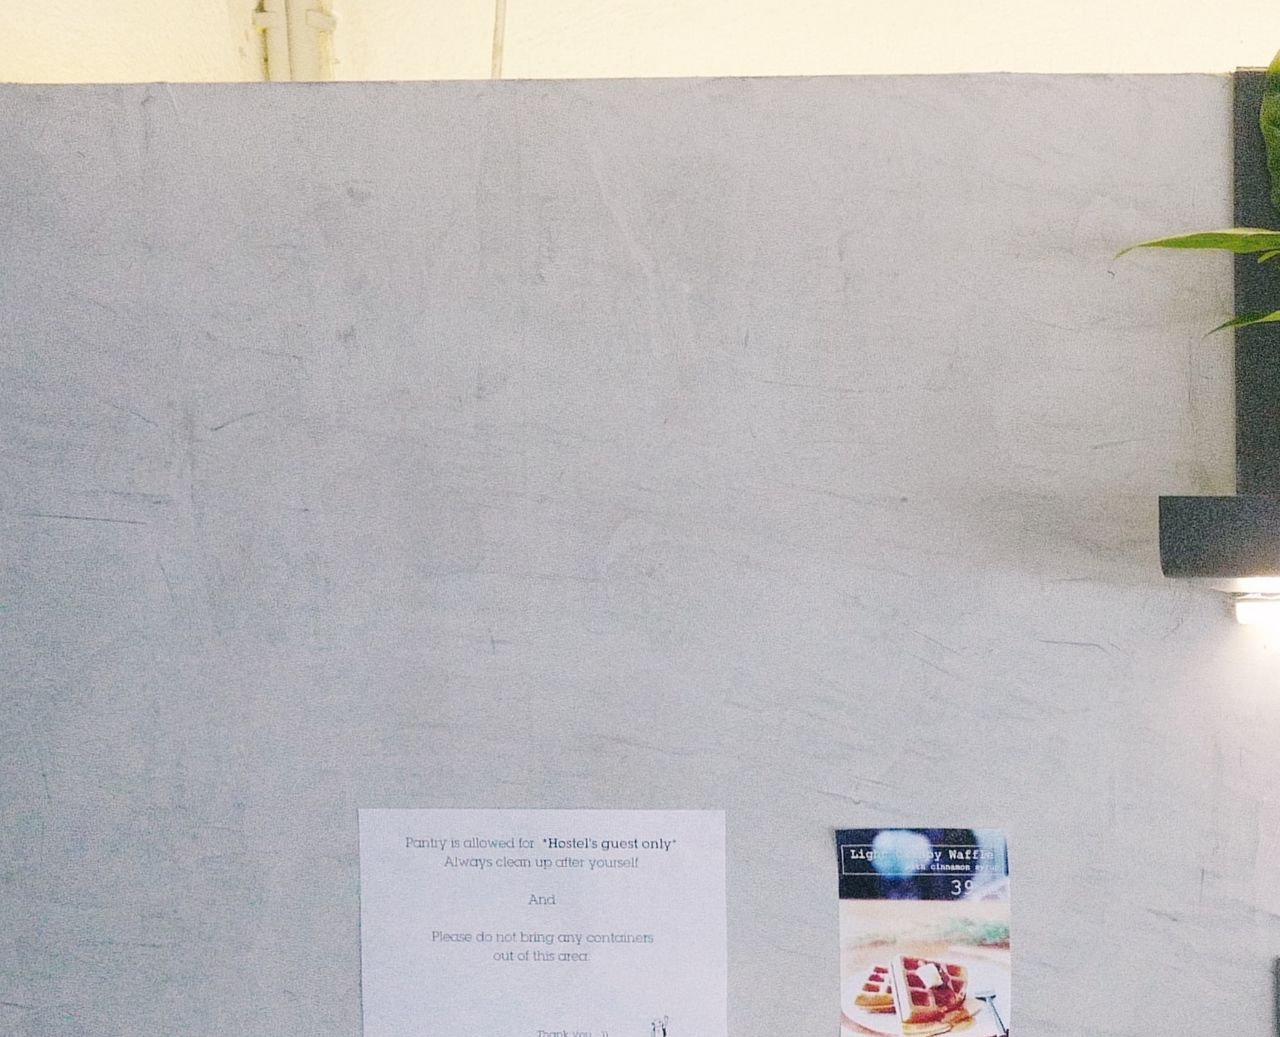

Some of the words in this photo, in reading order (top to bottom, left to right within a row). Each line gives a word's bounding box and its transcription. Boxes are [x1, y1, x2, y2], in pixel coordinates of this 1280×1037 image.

[405, 837, 447, 851] Pantry
[451, 838, 460, 848] is
[463, 837, 514, 849] allowed
[518, 837, 535, 849] for
[601, 838, 639, 852] guest
[444, 856, 493, 869] Always
[496, 856, 531, 868] clean
[535, 859, 551, 871] up
[555, 856, 584, 868] after
[588, 856, 639, 870] yourself
[930, 863, 970, 871] cinnamon
[528, 894, 556, 906] And
[432, 931, 472, 943] Please
[476, 931, 493, 943] do
[496, 931, 516, 943] not
[520, 931, 554, 945] bring
[557, 934, 582, 945] any
[586, 931, 654, 944] containers
[493, 951, 514, 962] out
[517, 950, 528, 962] of
[533, 950, 555, 962] this
